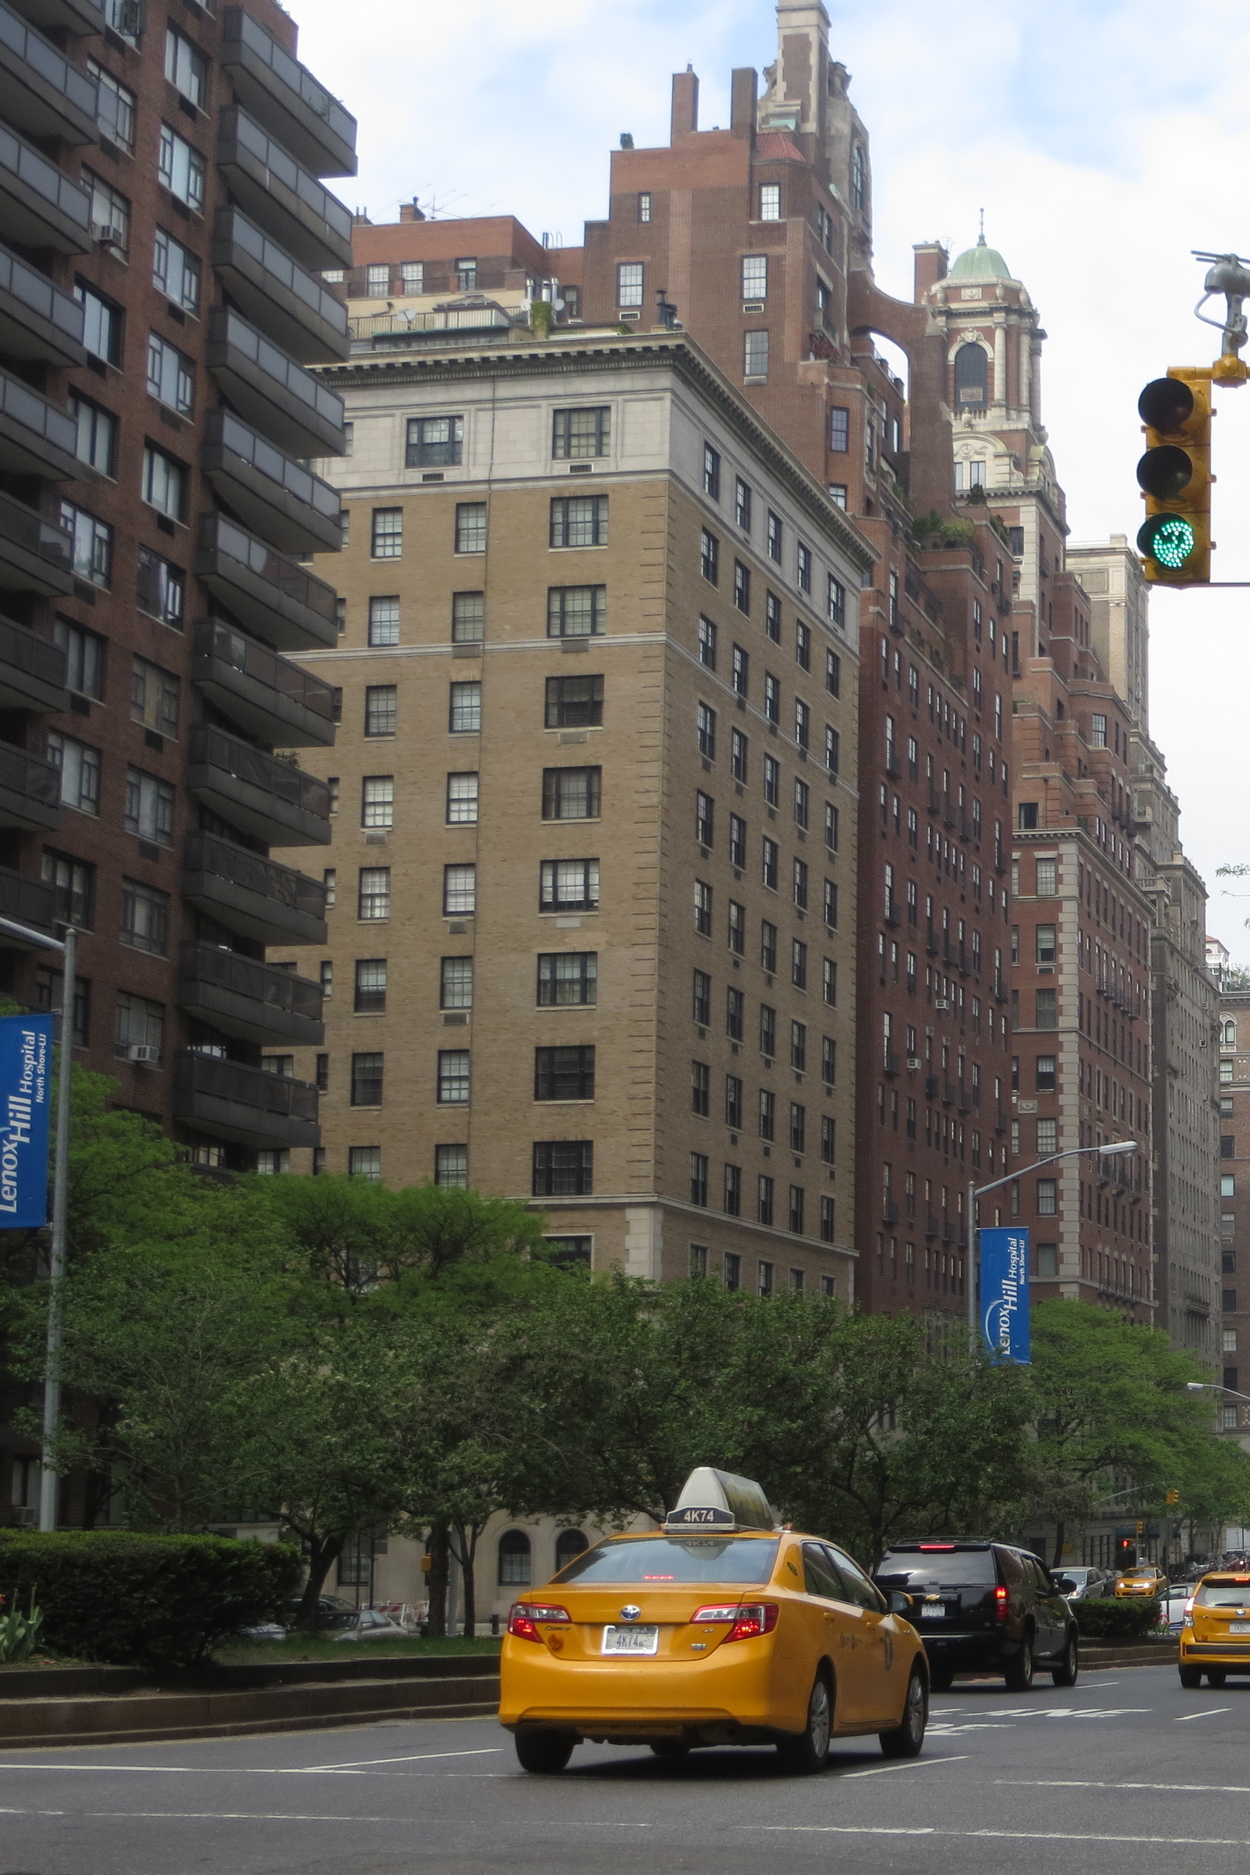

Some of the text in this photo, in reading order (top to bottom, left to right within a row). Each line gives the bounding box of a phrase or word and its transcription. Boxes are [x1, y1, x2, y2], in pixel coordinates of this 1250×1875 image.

[0, 1030, 38, 1213] Lenox Hill Hospital
[36, 1077, 45, 1104] North
[999, 1237, 1020, 1355] Lenox Hill Hospital
[684, 1510, 714, 1522] 4K74
